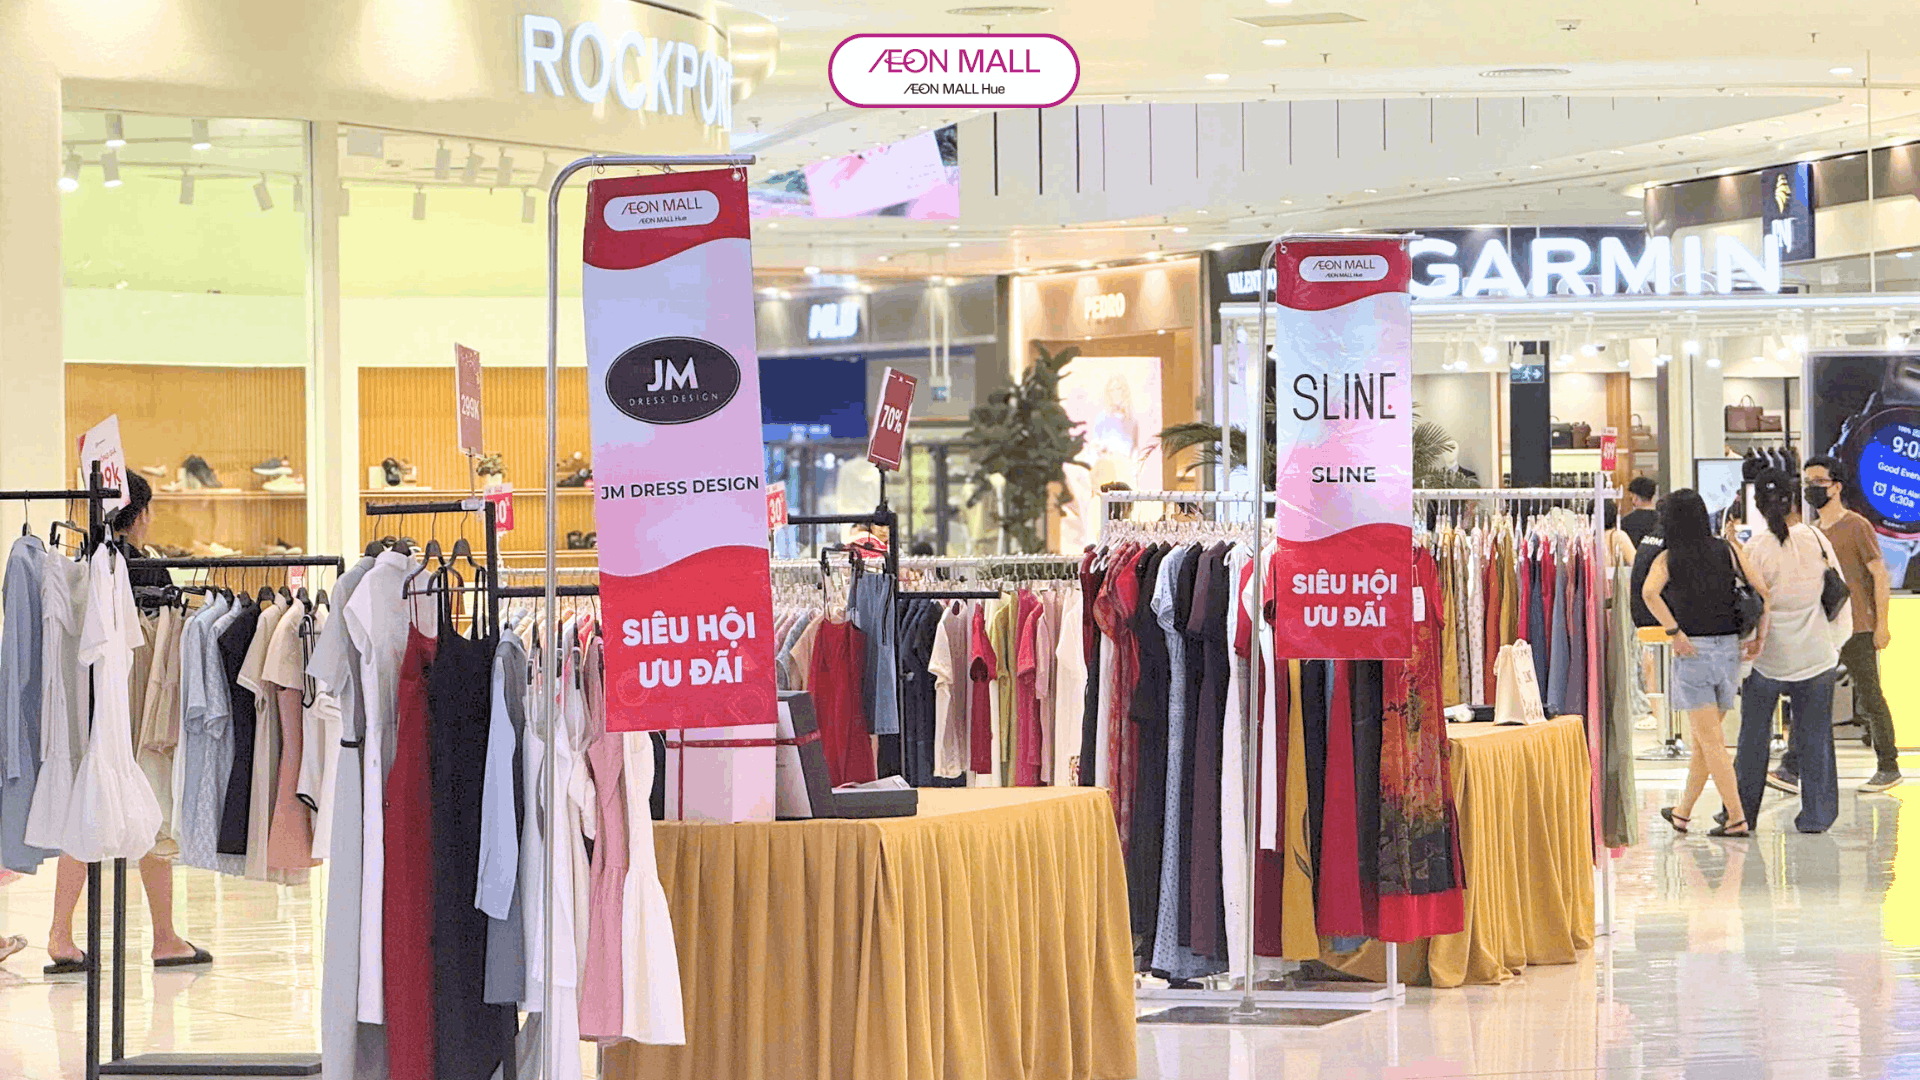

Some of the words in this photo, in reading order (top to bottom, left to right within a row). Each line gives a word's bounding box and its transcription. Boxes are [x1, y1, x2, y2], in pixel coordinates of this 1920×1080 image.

[662, 196, 703, 212] MALL
[1344, 259, 1376, 270] MALL
[1408, 233, 1782, 298] GARMIN
[1084, 292, 1126, 320] PEDRO
[646, 356, 699, 392] JM
[629, 395, 666, 407] DRESS
[672, 392, 719, 404] DESIGN
[880, 404, 903, 434] 70%
[1311, 466, 1377, 483] SLINE
[1877, 461, 1901, 475] Good
[601, 485, 625, 500] JM
[631, 480, 688, 498] DRESS
[692, 475, 759, 494] DESIGN
[1291, 568, 1347, 595] SIÊU
[1352, 568, 1398, 601] HỘI
[622, 610, 690, 647] SIÊU
[696, 605, 756, 649] HỘI
[1303, 604, 1338, 627] ƯU
[1343, 600, 1387, 627] ĐÃI
[638, 657, 682, 689] ƯU
[688, 648, 743, 686] ĐÃI
